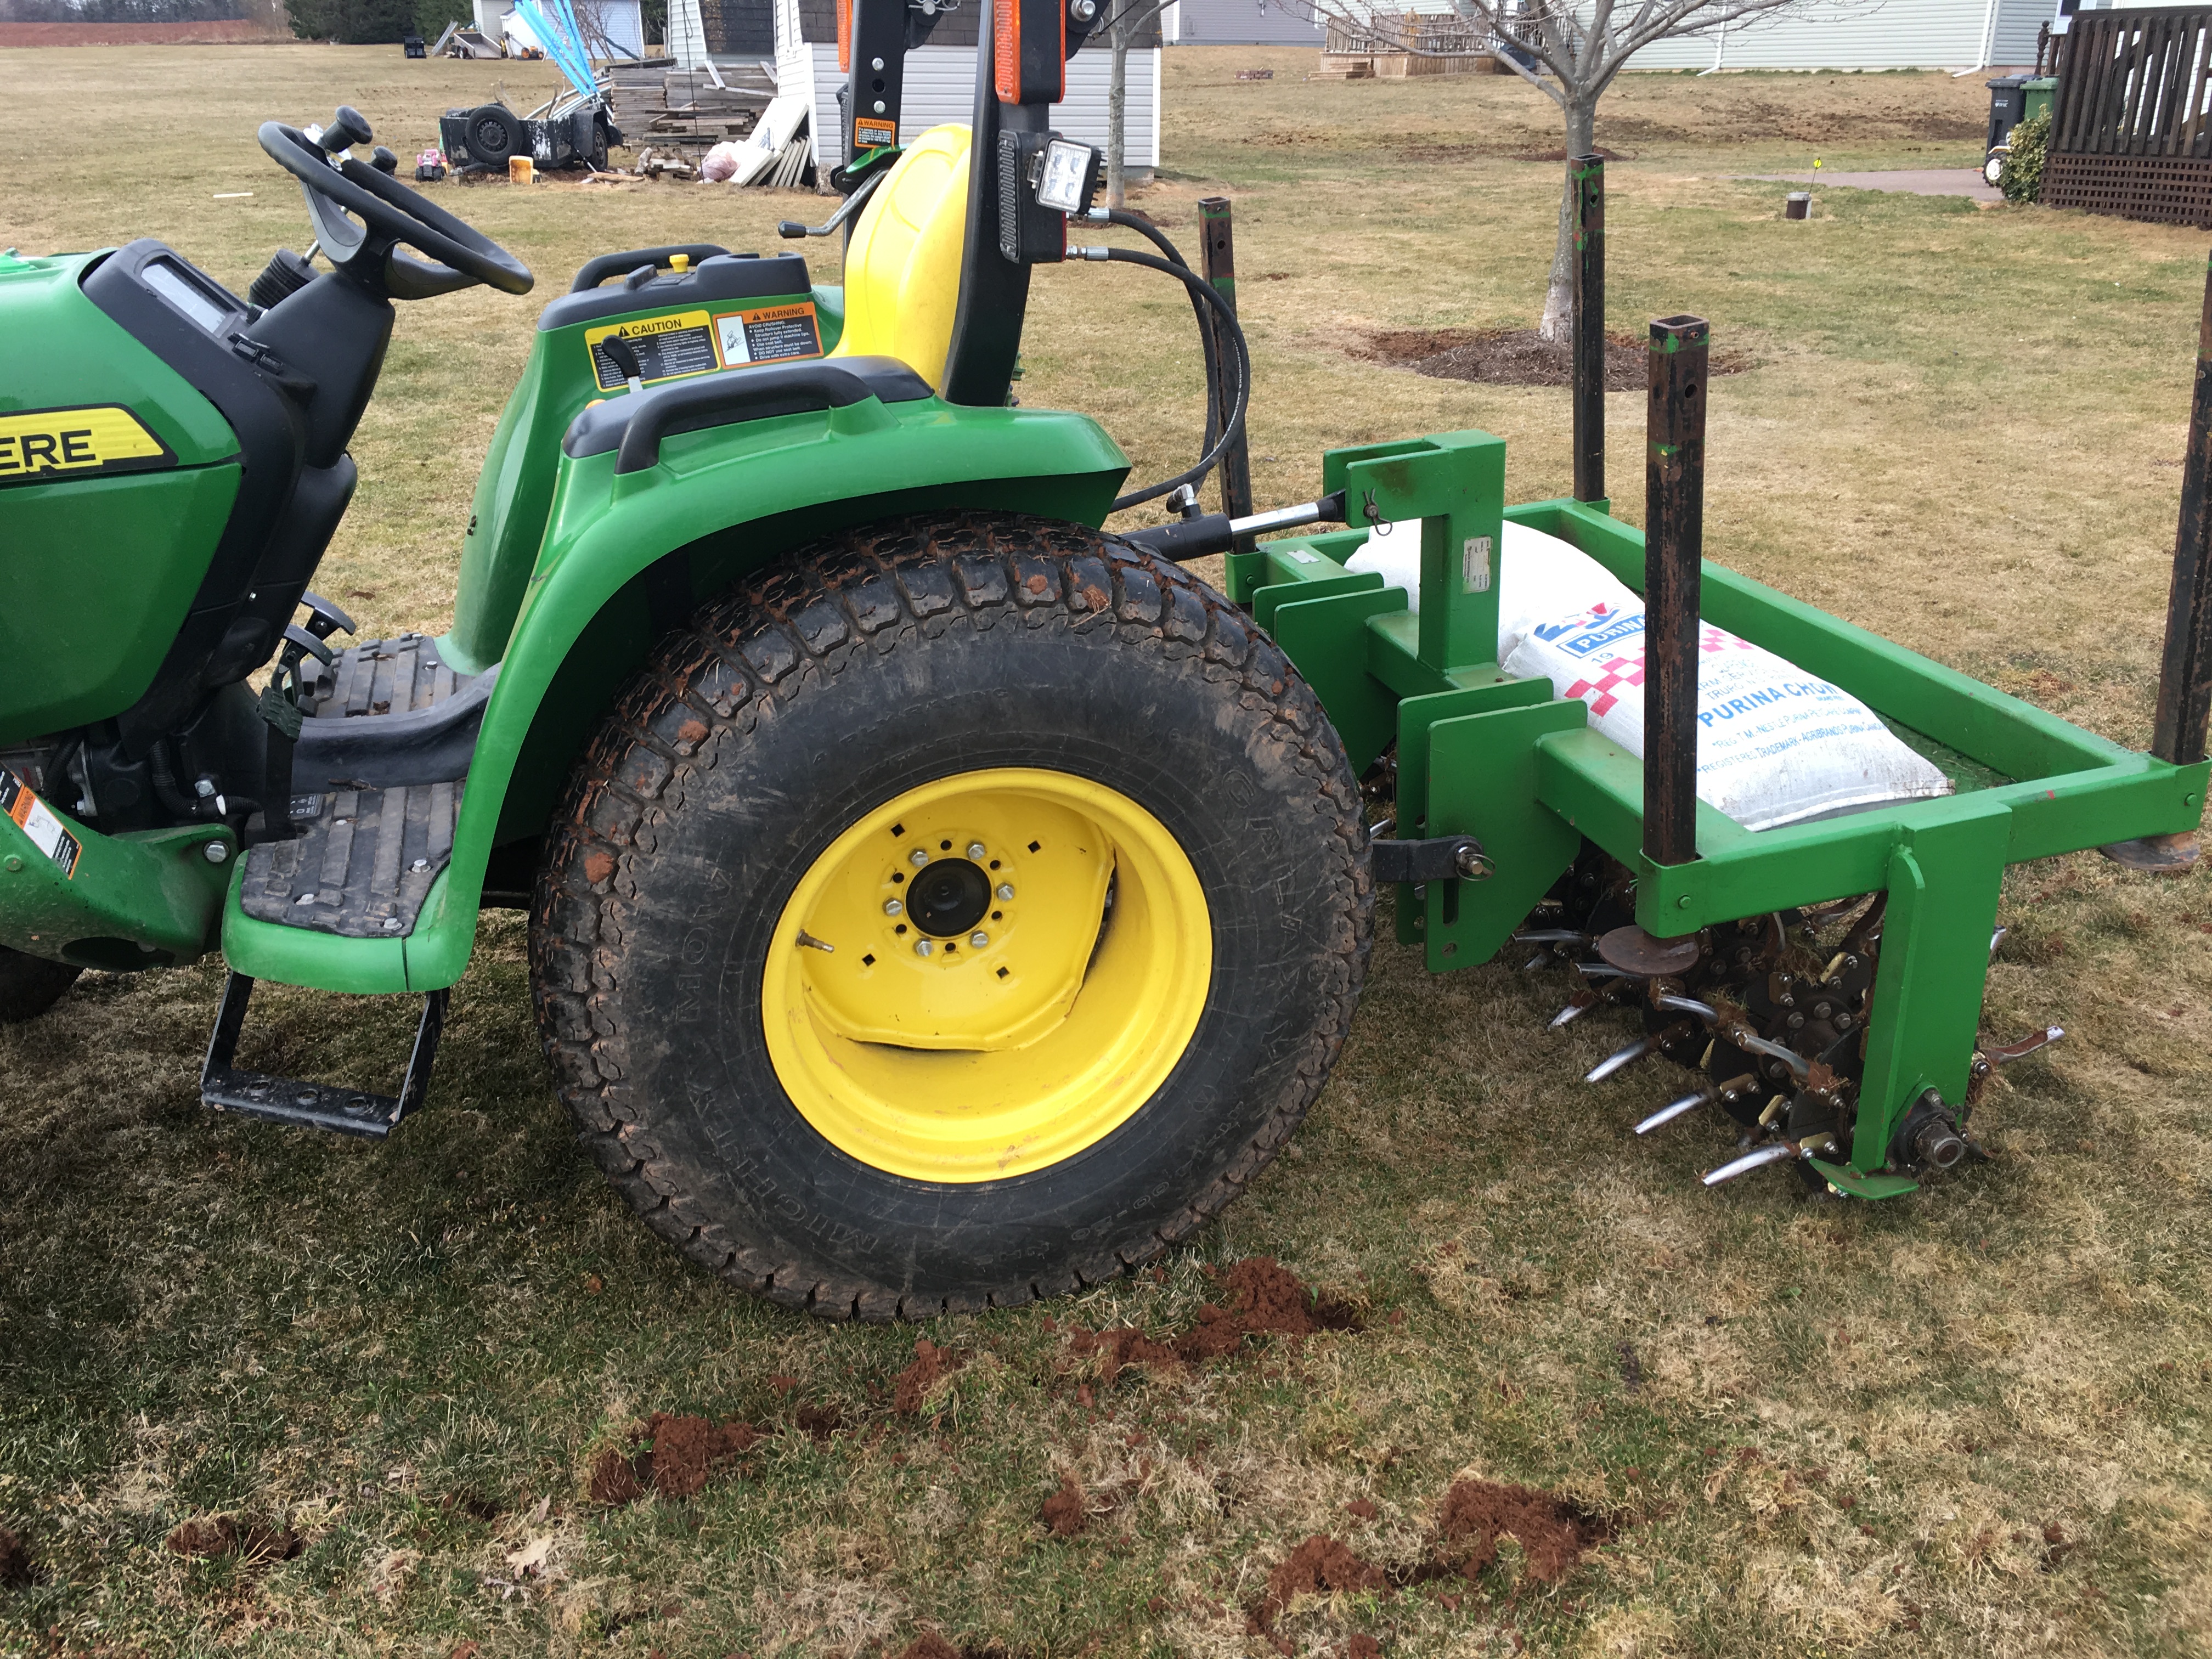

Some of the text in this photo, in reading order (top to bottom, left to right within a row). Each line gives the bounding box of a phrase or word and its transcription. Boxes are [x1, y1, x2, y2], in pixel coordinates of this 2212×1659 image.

[864, 120, 893, 128] WARNING
[763, 307, 804, 319] WARNING
[631, 319, 682, 335] CAUTION
[1591, 652, 1614, 663] 19
[1699, 682, 1839, 727] PURINA CHOW
[1754, 736, 1801, 758] TRADEMARK
[1801, 725, 1844, 743] AGRIBRANDS
